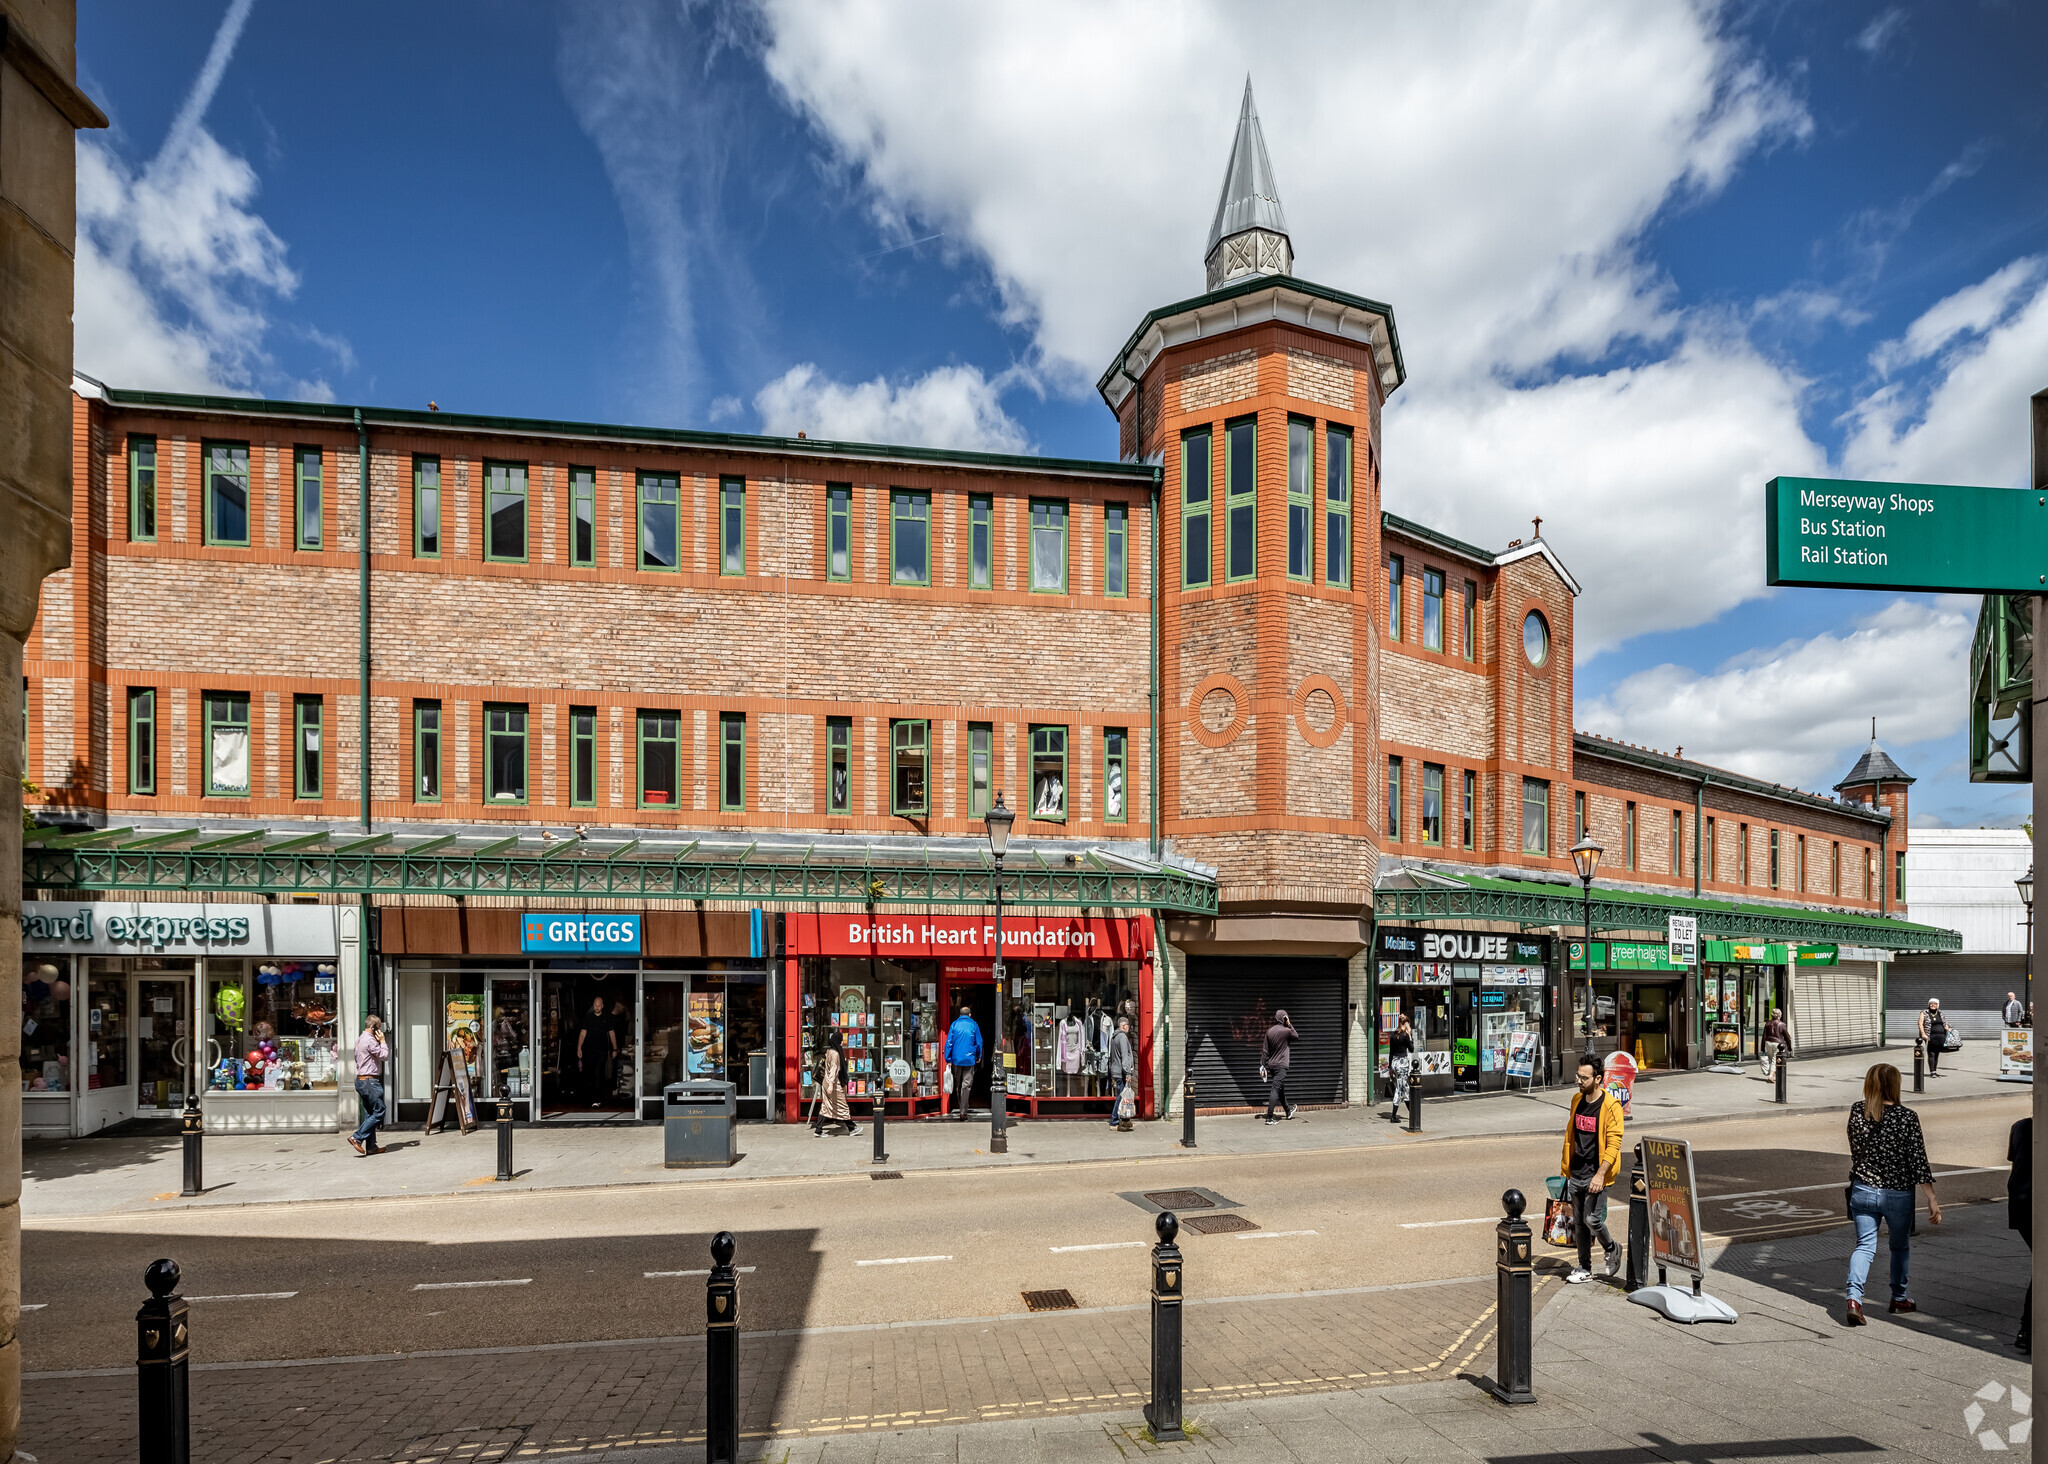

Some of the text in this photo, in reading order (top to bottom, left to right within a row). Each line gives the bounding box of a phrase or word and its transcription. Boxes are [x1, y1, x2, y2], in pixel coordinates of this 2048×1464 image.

[1800, 489, 1934, 515] Merseyway Shops
[1800, 518, 1886, 538] Bus Station
[1801, 545, 1888, 566] Rail Station
[105, 916, 249, 946] express
[548, 921, 634, 943] GREGGS
[1672, 919, 1694, 928] RETAIL UNIT
[849, 924, 1096, 946] British Heart Foundation
[1674, 928, 1693, 940] TO LET
[1385, 936, 1416, 951] Mobiles
[1423, 933, 1508, 960] BOUJEE
[1517, 942, 1539, 958] Vapes
[1611, 945, 1667, 963] greenhalgh's
[1800, 952, 1835, 960] SUBWAY
[2008, 1032, 2028, 1040] BIG
[1648, 1141, 1680, 1159] VAPE
[1656, 1164, 1678, 1181] 365
[1649, 1180, 1666, 1190] CAFE
[1674, 1185, 1691, 1195] VAPE
[1657, 1193, 1686, 1206] LOUNGE
[1656, 1251, 1700, 1268] VAPE DRINK RELAX
